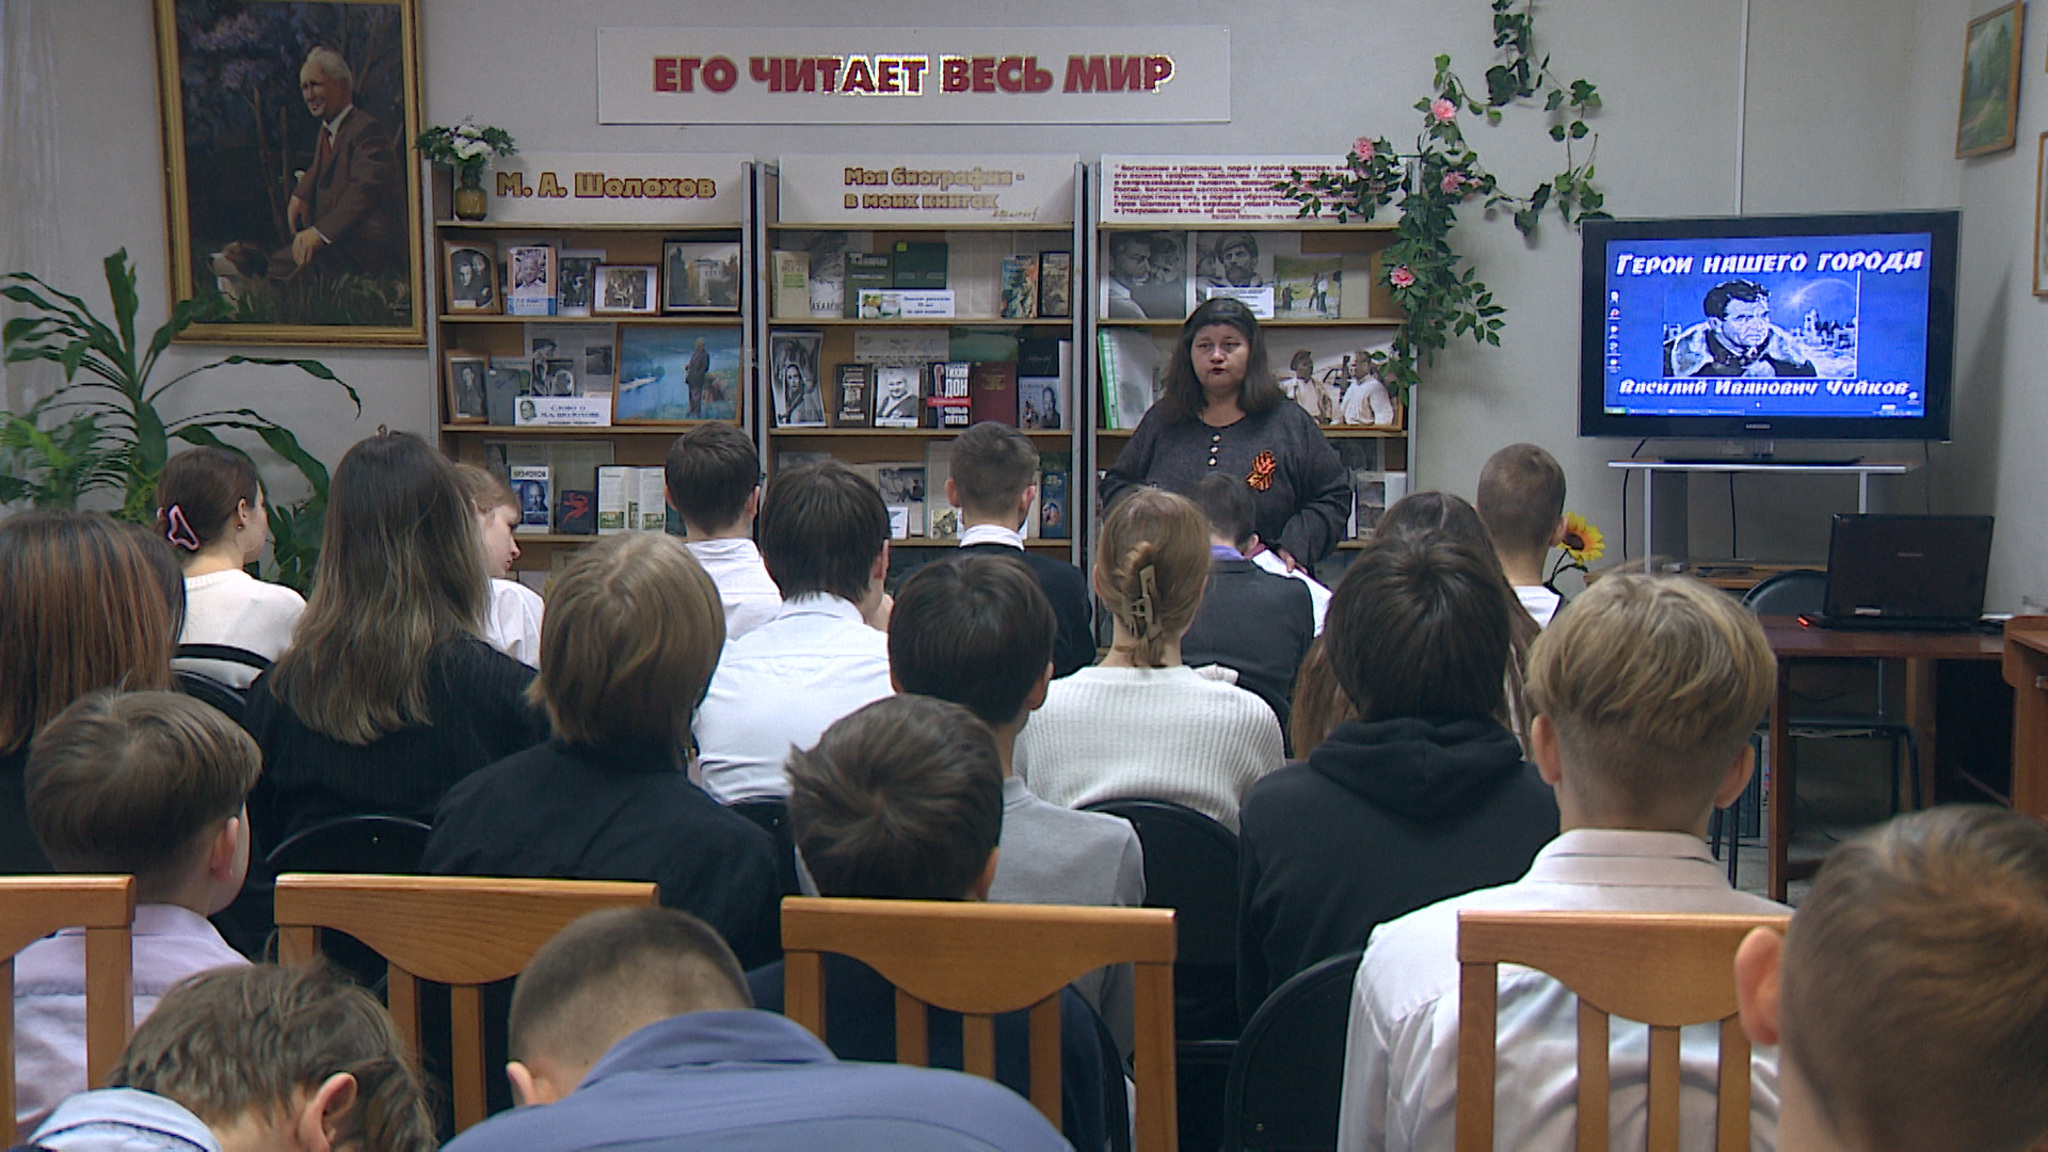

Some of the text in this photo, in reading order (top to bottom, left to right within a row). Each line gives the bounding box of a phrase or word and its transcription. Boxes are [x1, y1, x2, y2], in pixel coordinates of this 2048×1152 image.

[653, 54, 1175, 96] ЕГО ЧИТАЕТ ВЕСЬ МИР
[496, 172, 717, 199] М. А. Шолохов
[844, 168, 888, 186] Моя
[891, 166, 1013, 192] биография
[862, 193, 920, 209] моих
[922, 193, 999, 209] книгах
[1616, 250, 1924, 275] ГЕРОИ НАШЕГО ГОРОДА
[945, 379, 969, 398] ДОН
